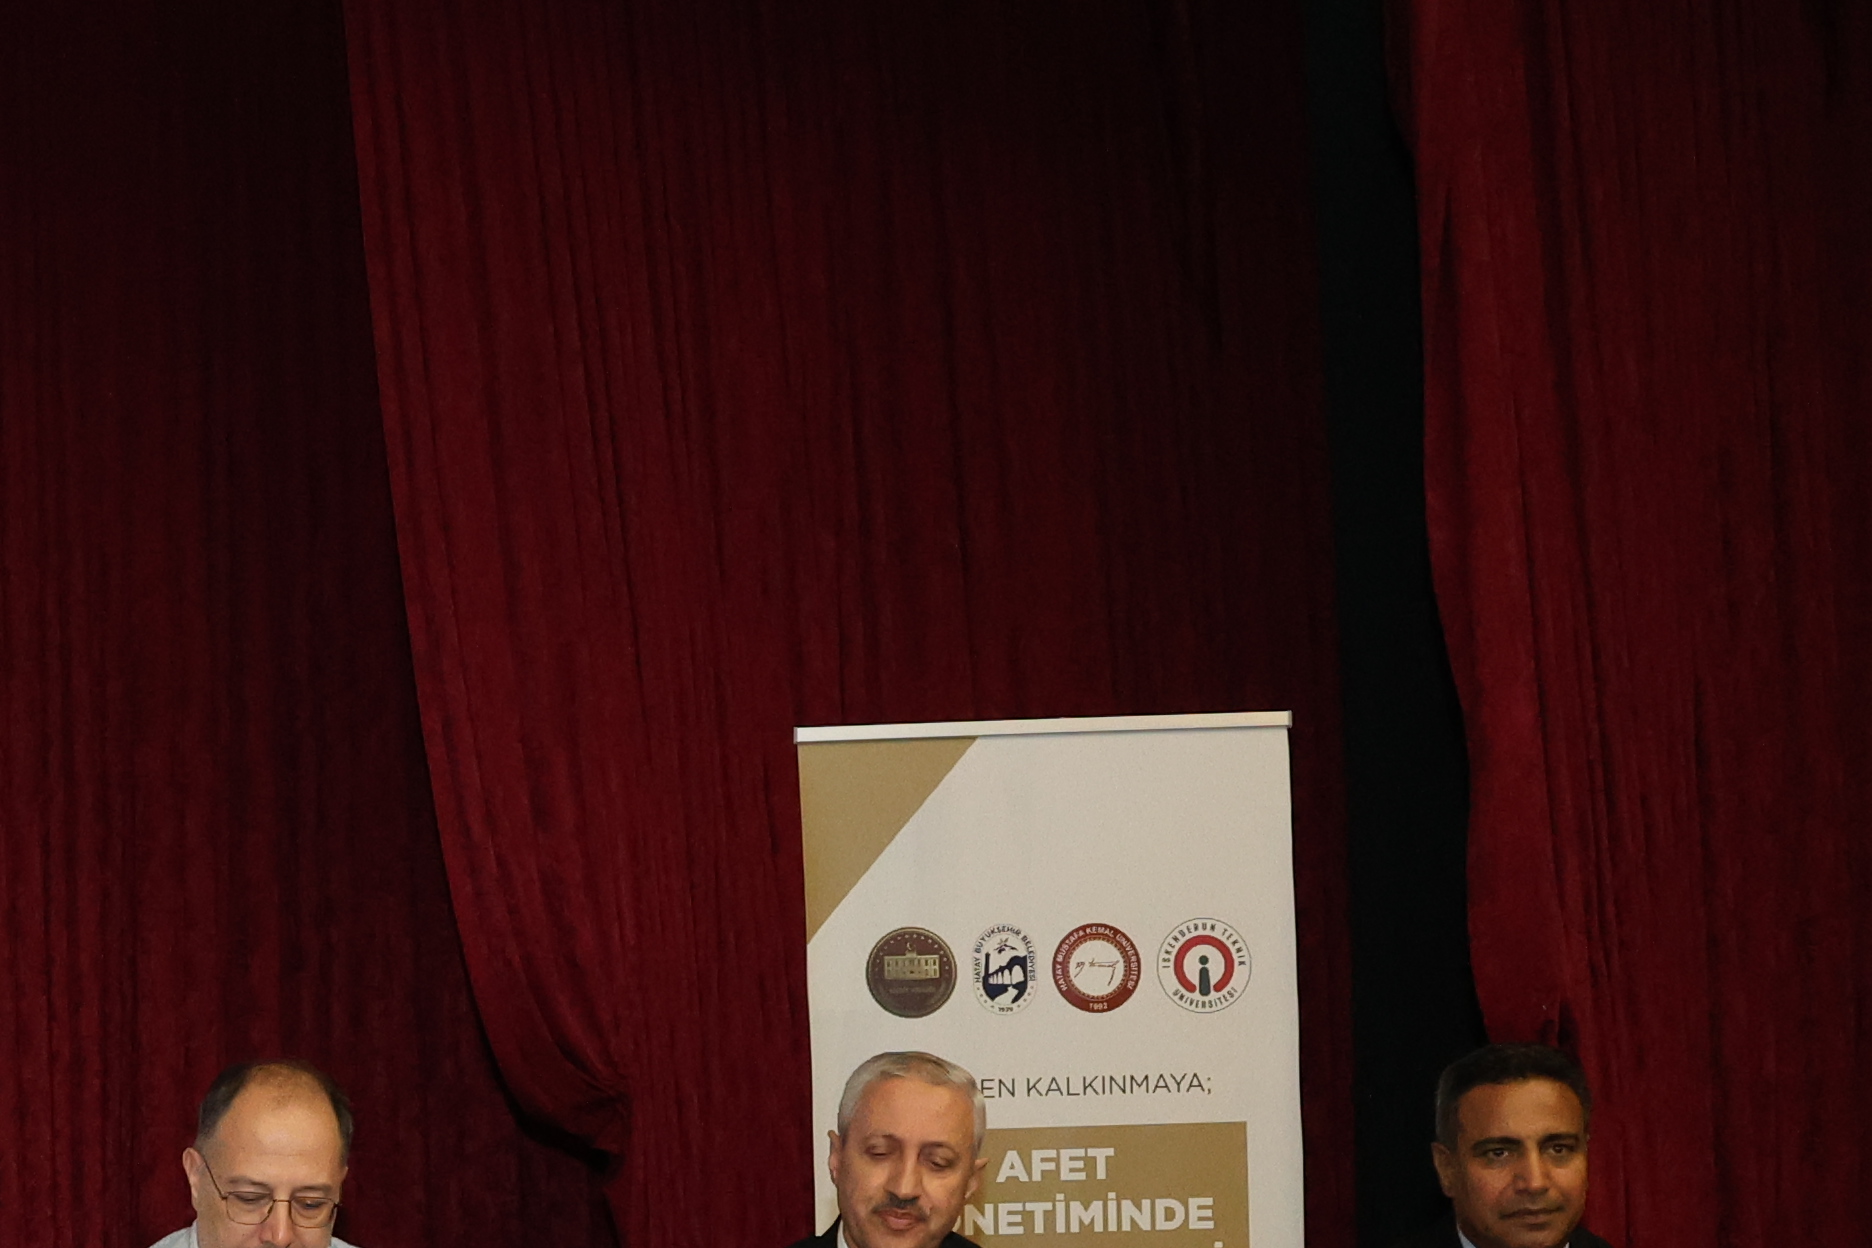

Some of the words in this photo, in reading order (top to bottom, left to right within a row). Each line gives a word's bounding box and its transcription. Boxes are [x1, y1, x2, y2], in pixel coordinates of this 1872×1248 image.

[1085, 926, 1115, 938] KEMAL
[980, 1078, 1016, 1099] EN
[1026, 1072, 1213, 1098] KALKINMAYA;
[995, 1147, 1115, 1183] AFET
[953, 1191, 1215, 1236] NETİMİNDE
